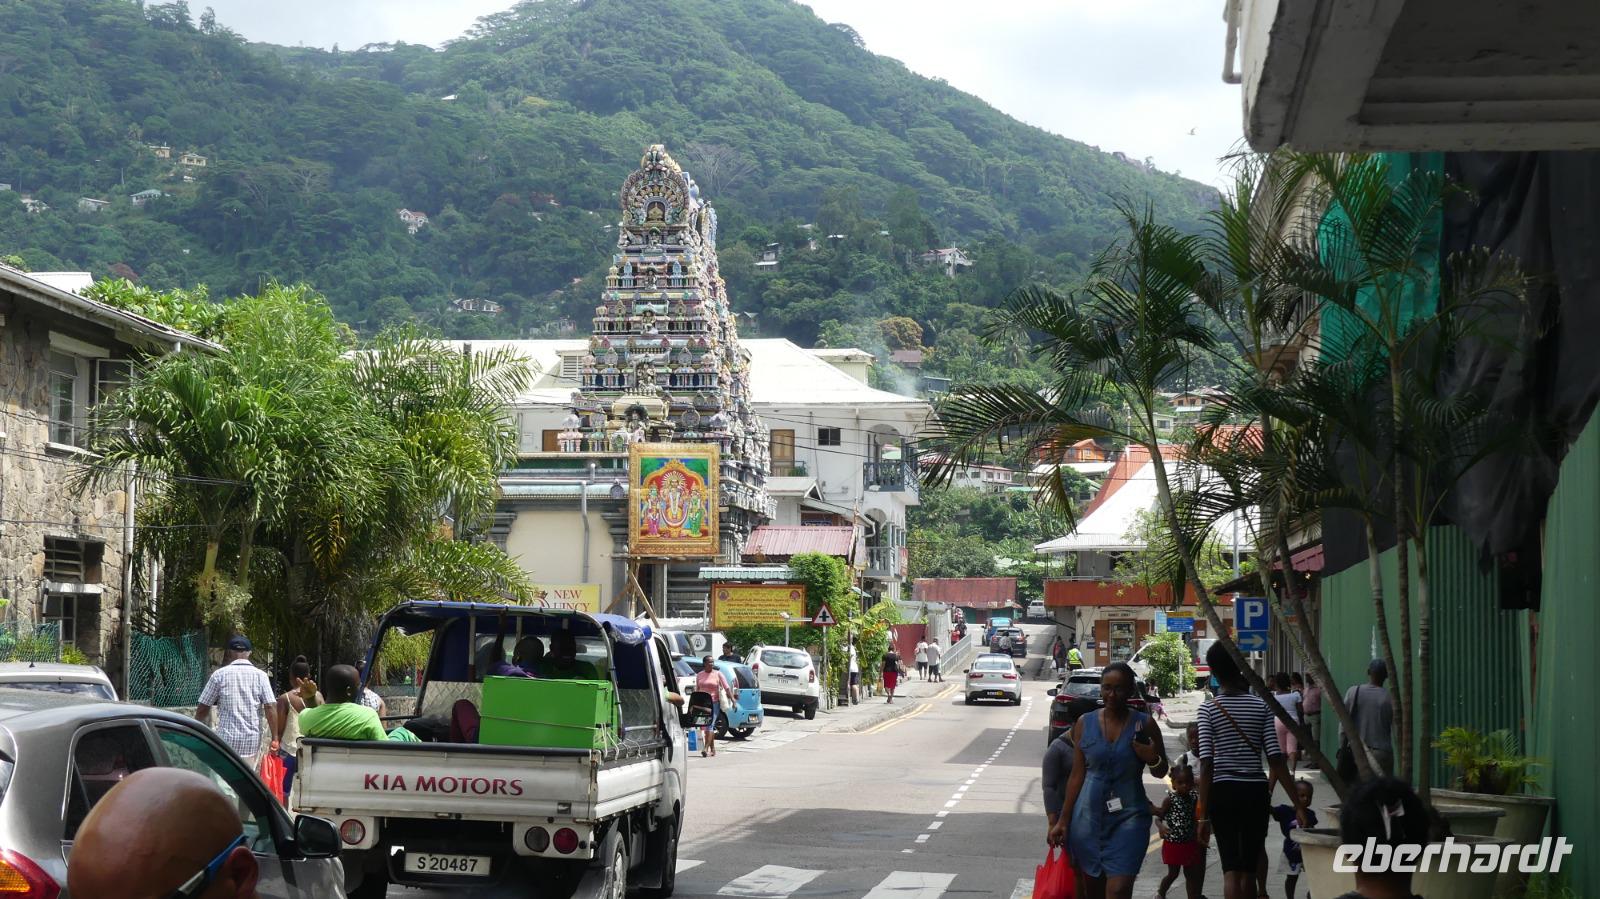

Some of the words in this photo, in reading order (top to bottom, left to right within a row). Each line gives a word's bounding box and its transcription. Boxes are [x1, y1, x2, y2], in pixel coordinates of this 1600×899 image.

[553, 589, 582, 599] NEW
[1243, 601, 1264, 629] P
[364, 774, 407, 791] KIA
[415, 775, 523, 796] MOTORS
[417, 856, 426, 869] S
[429, 857, 478, 872] 20487
